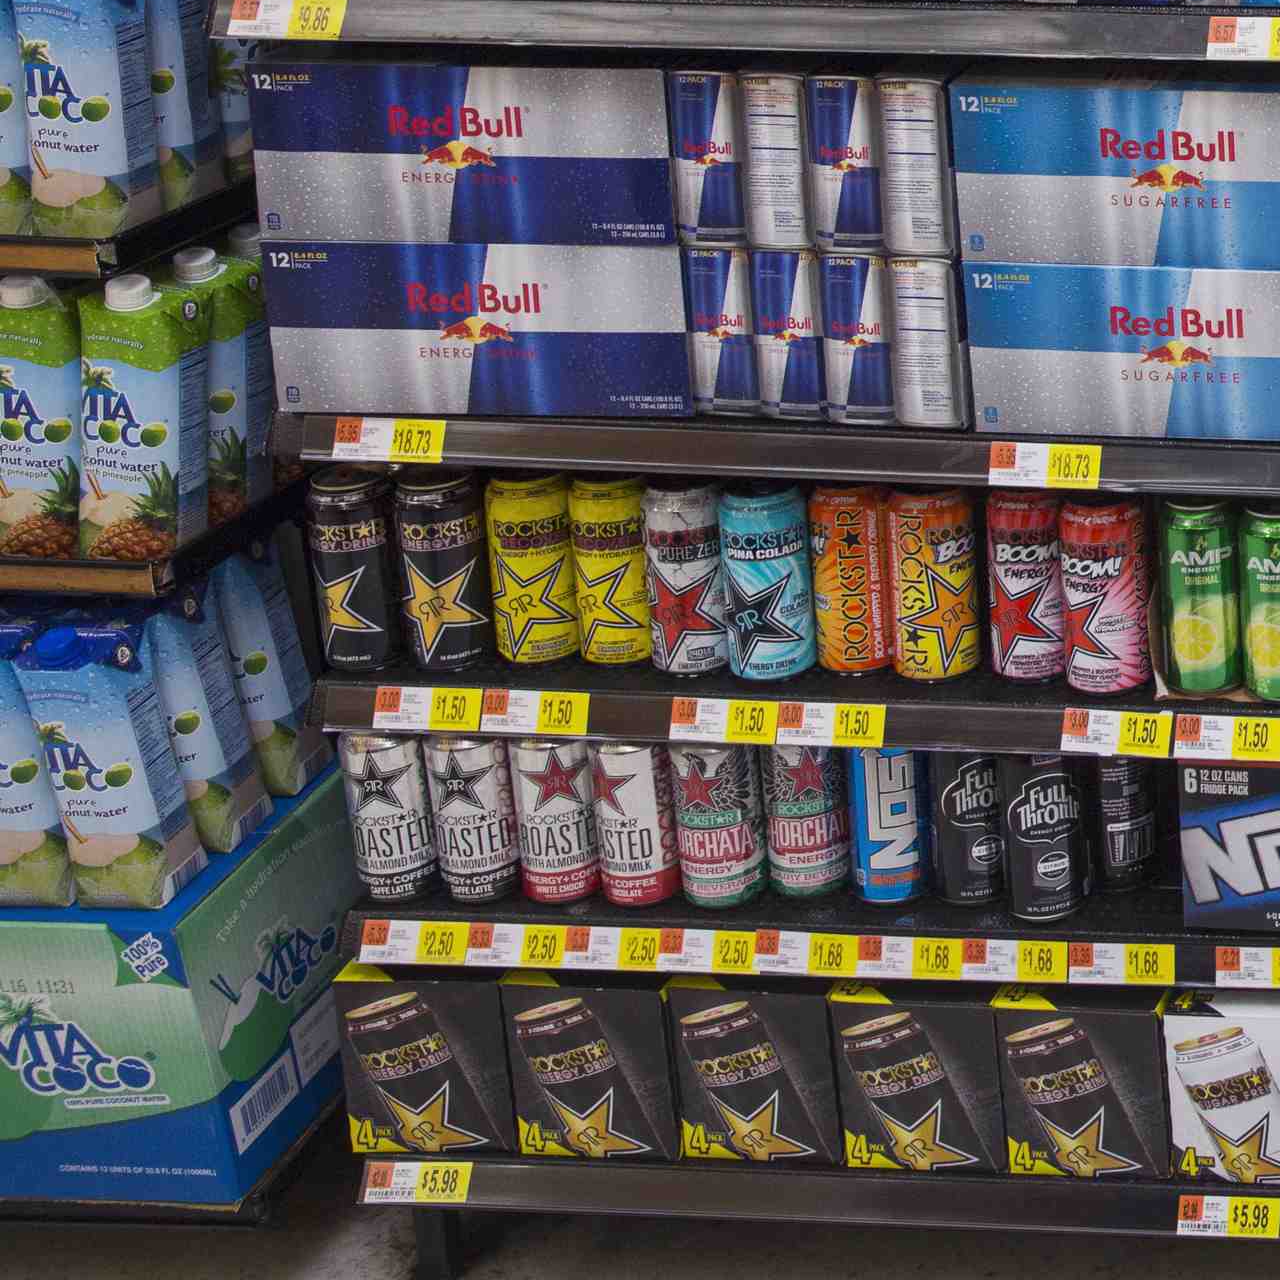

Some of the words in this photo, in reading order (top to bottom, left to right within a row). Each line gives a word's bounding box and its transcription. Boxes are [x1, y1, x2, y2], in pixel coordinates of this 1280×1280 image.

[38, 127, 69, 139] pure
[388, 106, 454, 138] Red
[460, 106, 524, 138] Bull
[65, 143, 100, 155] water
[393, 429, 431, 456] $18.73
[1169, 550, 1231, 566] AMP
[1184, 575, 1219, 585] ORIGINAL
[1238, 722, 1268, 748] $1.50
[1185, 769, 1196, 793] 6
[1201, 772, 1210, 783] 12
[1211, 771, 1224, 783] OZ
[1227, 771, 1248, 783] CANS
[1200, 783, 1224, 795] FRIDGE
[1227, 783, 1248, 796] PACK
[124, 935, 159, 962] 100%
[424, 930, 452, 956] $2.50
[135, 956, 166, 977] Pure
[920, 945, 949, 971] $1.68
[1233, 1204, 1269, 1230] $5.98
